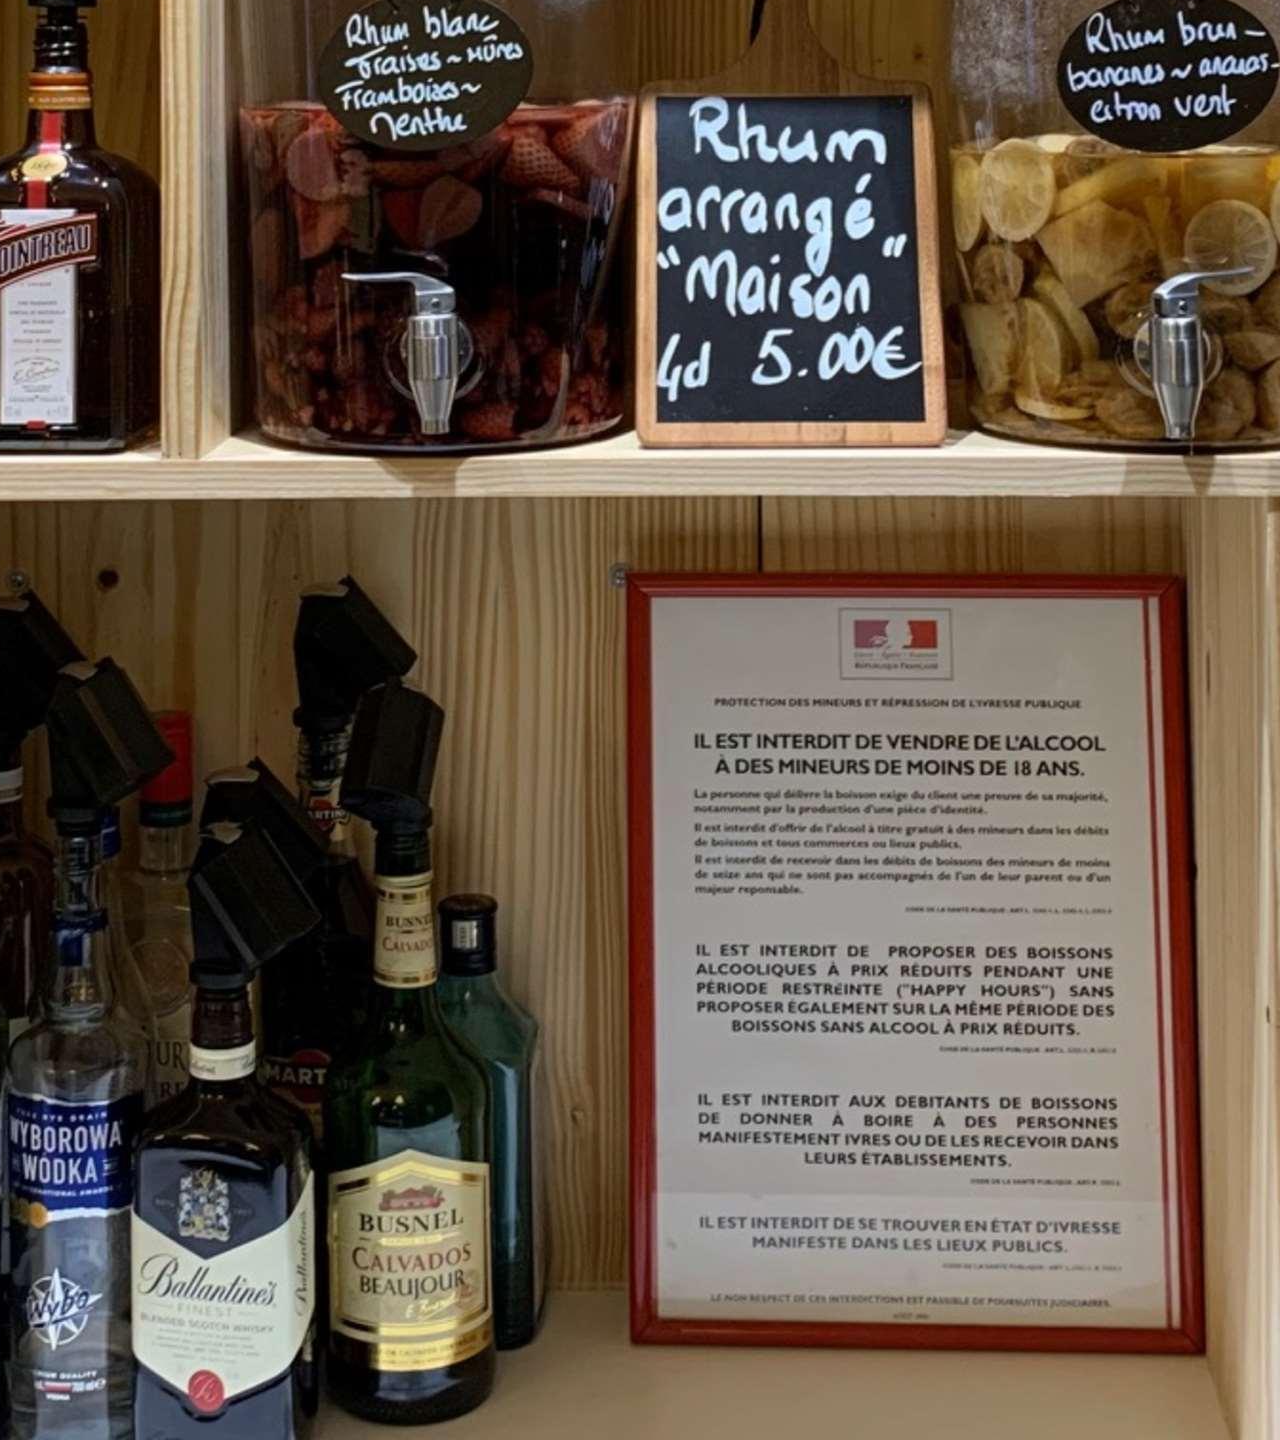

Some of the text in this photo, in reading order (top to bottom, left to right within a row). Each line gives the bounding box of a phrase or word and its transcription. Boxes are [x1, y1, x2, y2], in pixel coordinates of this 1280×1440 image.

[345, 5, 500, 48] Rhum blanc
[1084, 9, 1238, 54] Rhum brun
[1066, 61, 1166, 93] bananes
[1090, 83, 1238, 124] citron vert
[689, 96, 888, 165] Rhum
[658, 173, 876, 278] arrangé
[751, 324, 923, 386] 5.00€
[713, 697, 1081, 710] PROTECTION DES MINEURS ET RÉPRESSION DE L'IVRESSE PUBLIQUE
[694, 732, 1105, 753] IL EST INTERDIT DE VENDRE DE L'ALCOOL
[713, 756, 1086, 777] À DES MINEURS DE MOINS DE 18 ANS.
[694, 943, 1114, 961] IL EST INTERDIT DE PROPOSER DES BOISSONS
[692, 962, 1114, 980] ALCOOLIQUES À PRIX RÉDUITS PENDANT UNE
[695, 981, 768, 997] PÉRIODE
[895, 982, 967, 998] ("HAPPY
[979, 982, 1056, 999] HOURS")
[1068, 983, 1115, 999] SANS
[696, 999, 1115, 1018] PROPOSER ÉGALEMENT SUR LA MÊME PÉRIODE DES
[730, 1019, 1080, 1037] BOISSONS SANS ALCOOL À PRIX RÉDUITS.
[268, 1067, 328, 1086] MART
[9, 1114, 123, 1154] WYBOROWA
[22, 1151, 99, 1185] WÓDKA
[359, 1208, 465, 1234] BUSNEL
[698, 1216, 1121, 1235] IL EST INTERDIT DE SE TROUVER EN ÉTAT D'IVRESSE
[751, 1235, 1068, 1254] MANIFESTE DANS LES LIEUX PUBLICS.
[351, 1243, 472, 1274] CALVADOS
[137, 1252, 278, 1307] Ballantine's
[359, 1269, 466, 1300] BEAUJOUR
[29, 1286, 91, 1323] Wybo
[177, 1302, 233, 1318] FINEST
[188, 1318, 230, 1332] SCOTCH
